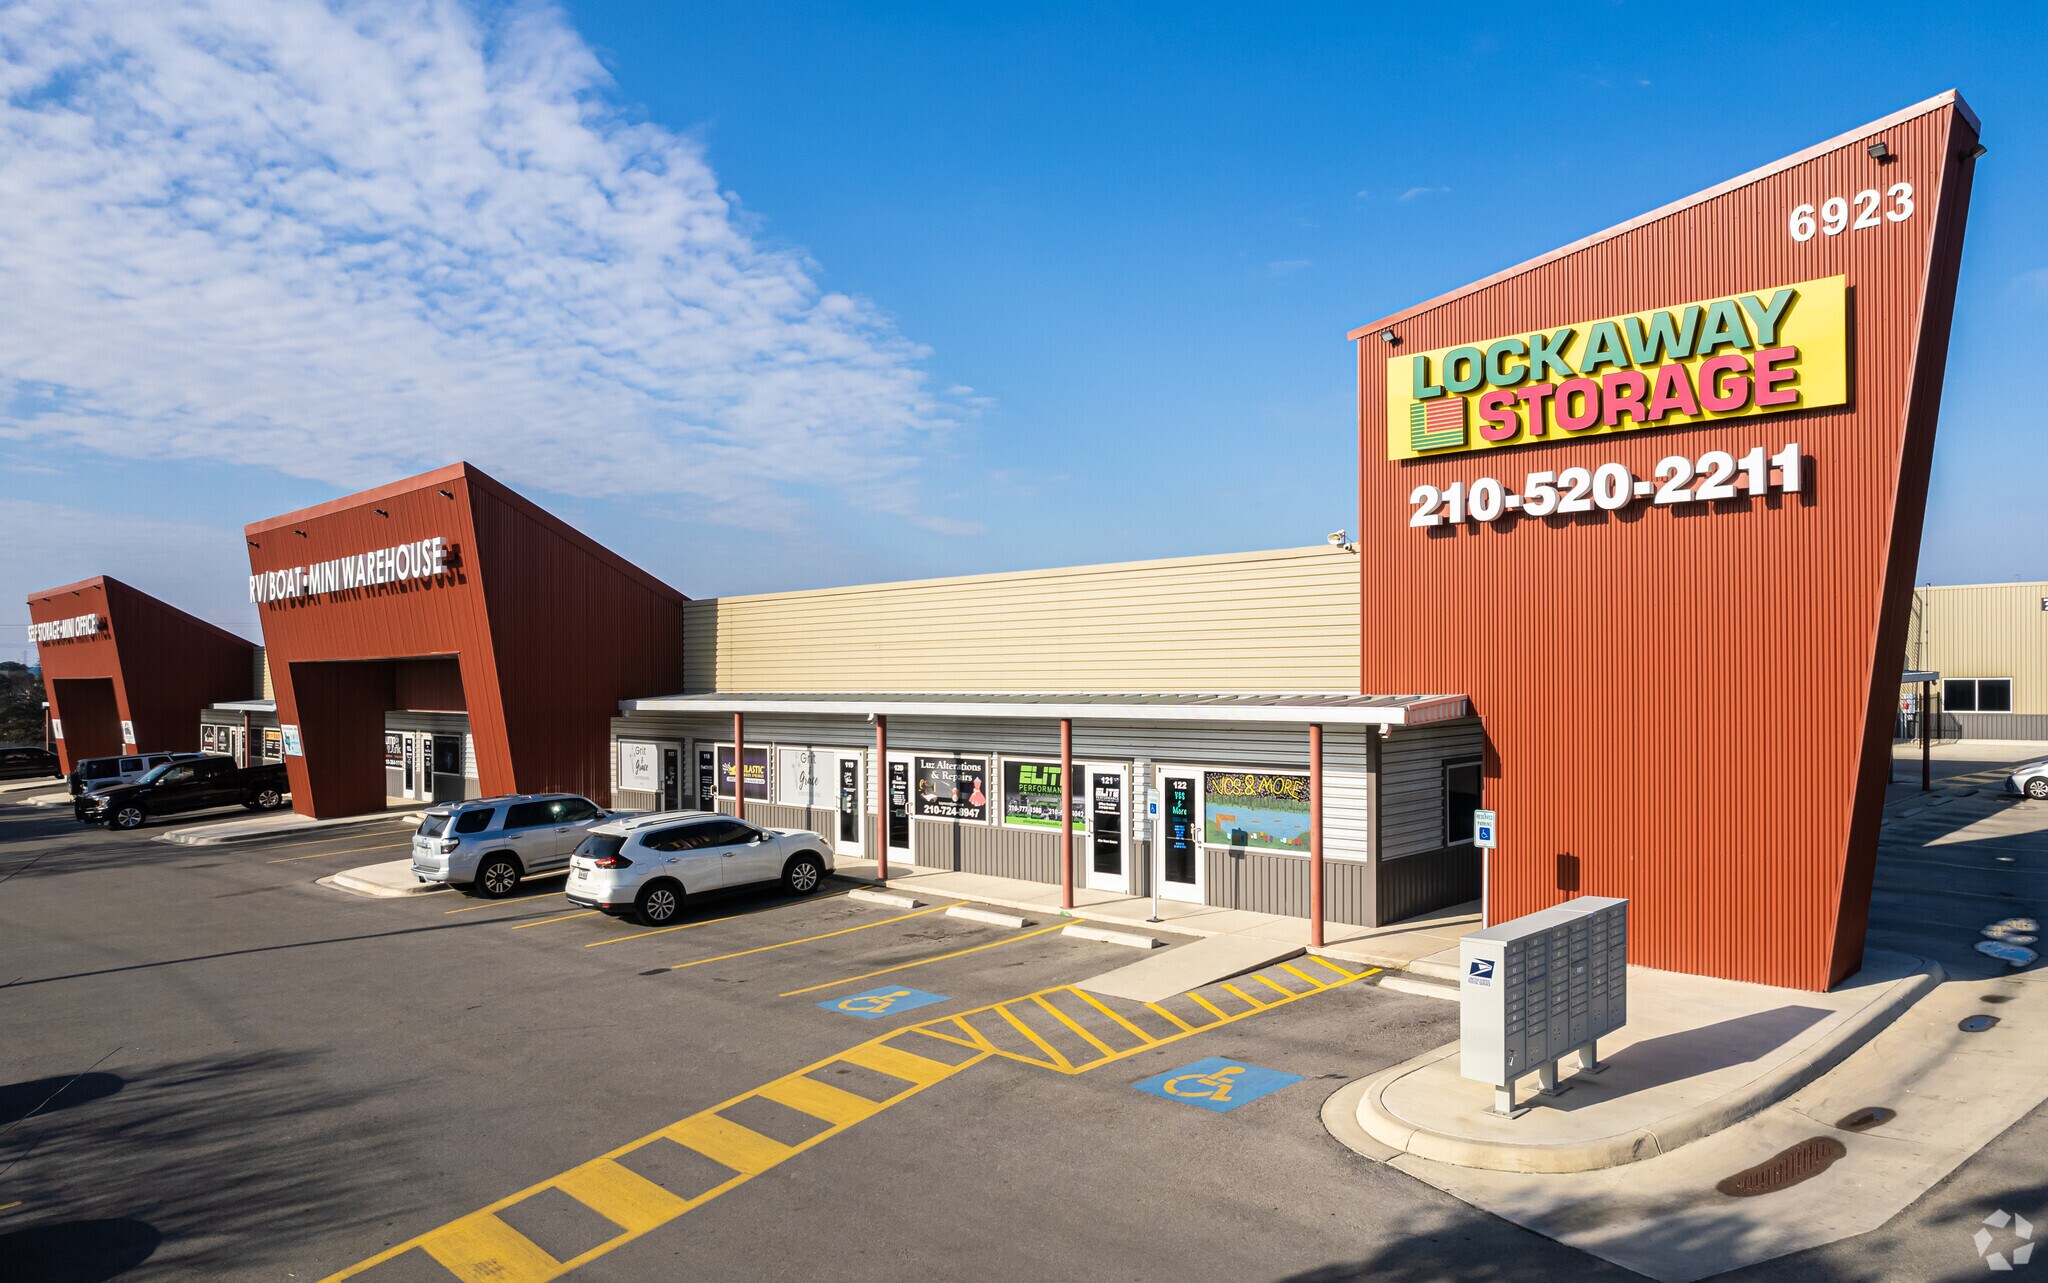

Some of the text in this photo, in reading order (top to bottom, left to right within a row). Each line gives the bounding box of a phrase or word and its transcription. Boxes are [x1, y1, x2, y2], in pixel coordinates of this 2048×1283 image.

[1789, 182, 1915, 242] 6923
[1479, 345, 1798, 442] STORAGE
[1409, 443, 1801, 527] 210-520-2211
[341, 537, 446, 590] WAREHOUSE
[38, 620, 60, 642] STORAGE
[75, 613, 98, 637] OFFICE
[635, 746, 646, 755] Grit
[635, 759, 649, 775] Grace
[845, 761, 854, 769] 119
[894, 764, 904, 772] 120
[920, 759, 982, 772] Luz Alterations
[930, 770, 973, 782] & Repairs
[1019, 765, 1063, 786] ELIT
[1101, 776, 1114, 785] 121
[1018, 784, 1063, 794] PERFORMAN
[1173, 781, 1188, 790] 122
[1244, 774, 1257, 796] &
[1258, 777, 1304, 800] MORE
[1095, 787, 1120, 798] ELITE
[1172, 806, 1188, 815] More
